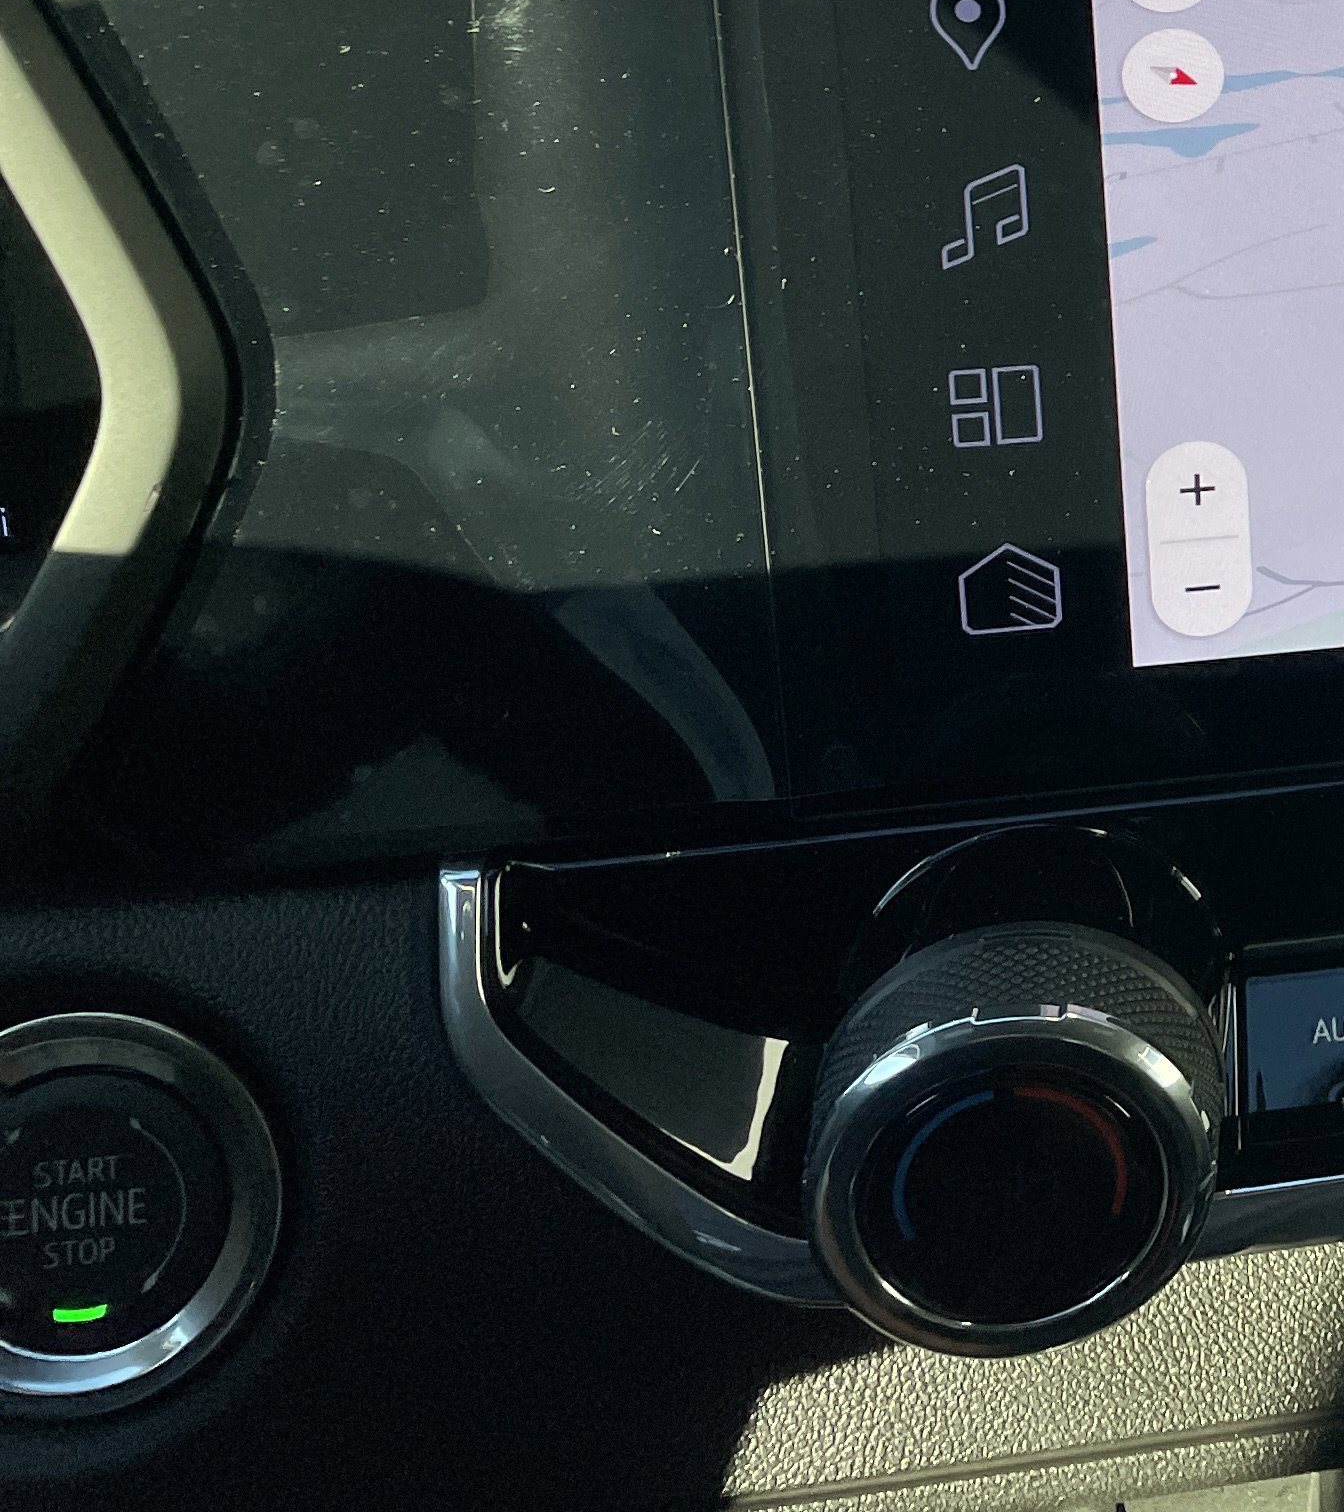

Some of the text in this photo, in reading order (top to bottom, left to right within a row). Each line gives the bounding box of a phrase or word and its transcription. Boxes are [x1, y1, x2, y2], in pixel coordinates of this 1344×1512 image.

[33, 1154, 120, 1189] START
[0, 1187, 149, 1239] ENGINE
[43, 1236, 117, 1270] STOP
